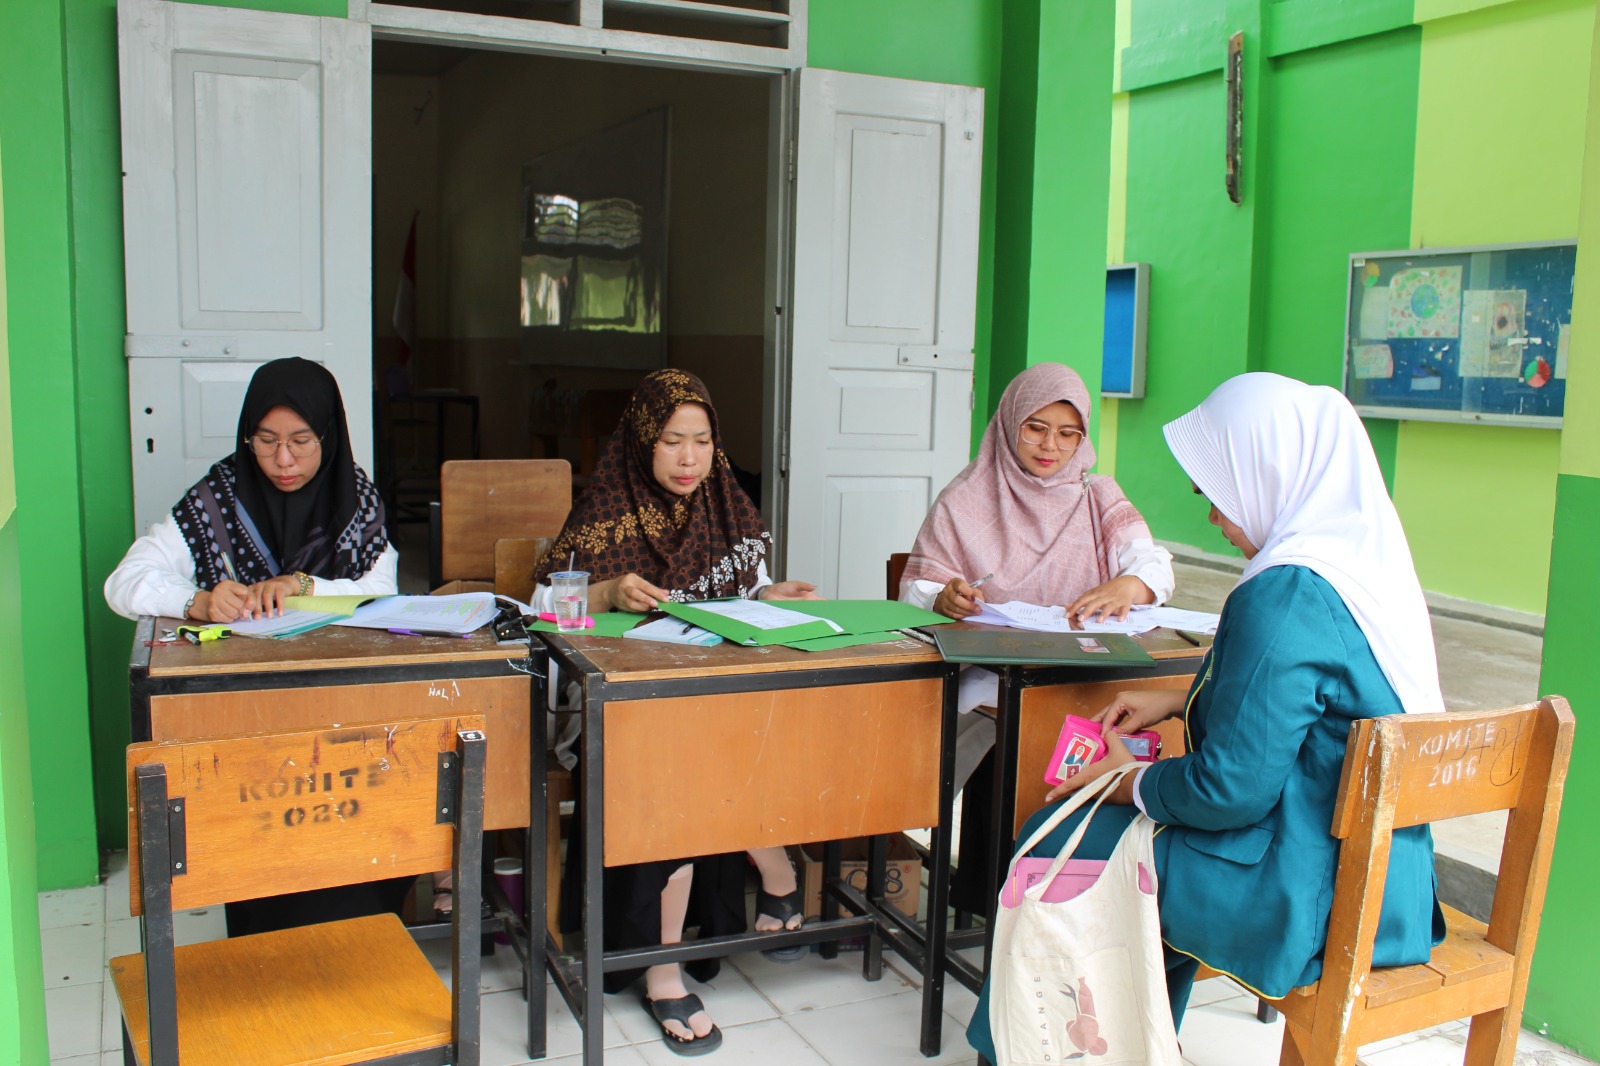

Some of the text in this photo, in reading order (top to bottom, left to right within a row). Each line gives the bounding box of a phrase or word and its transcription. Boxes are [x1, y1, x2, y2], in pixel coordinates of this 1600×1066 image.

[1418, 720, 1498, 757] KOMITE
[239, 763, 387, 803] KOMITE
[1427, 755, 1479, 788] 2016
[1033, 976, 1052, 1062] ORANGE
